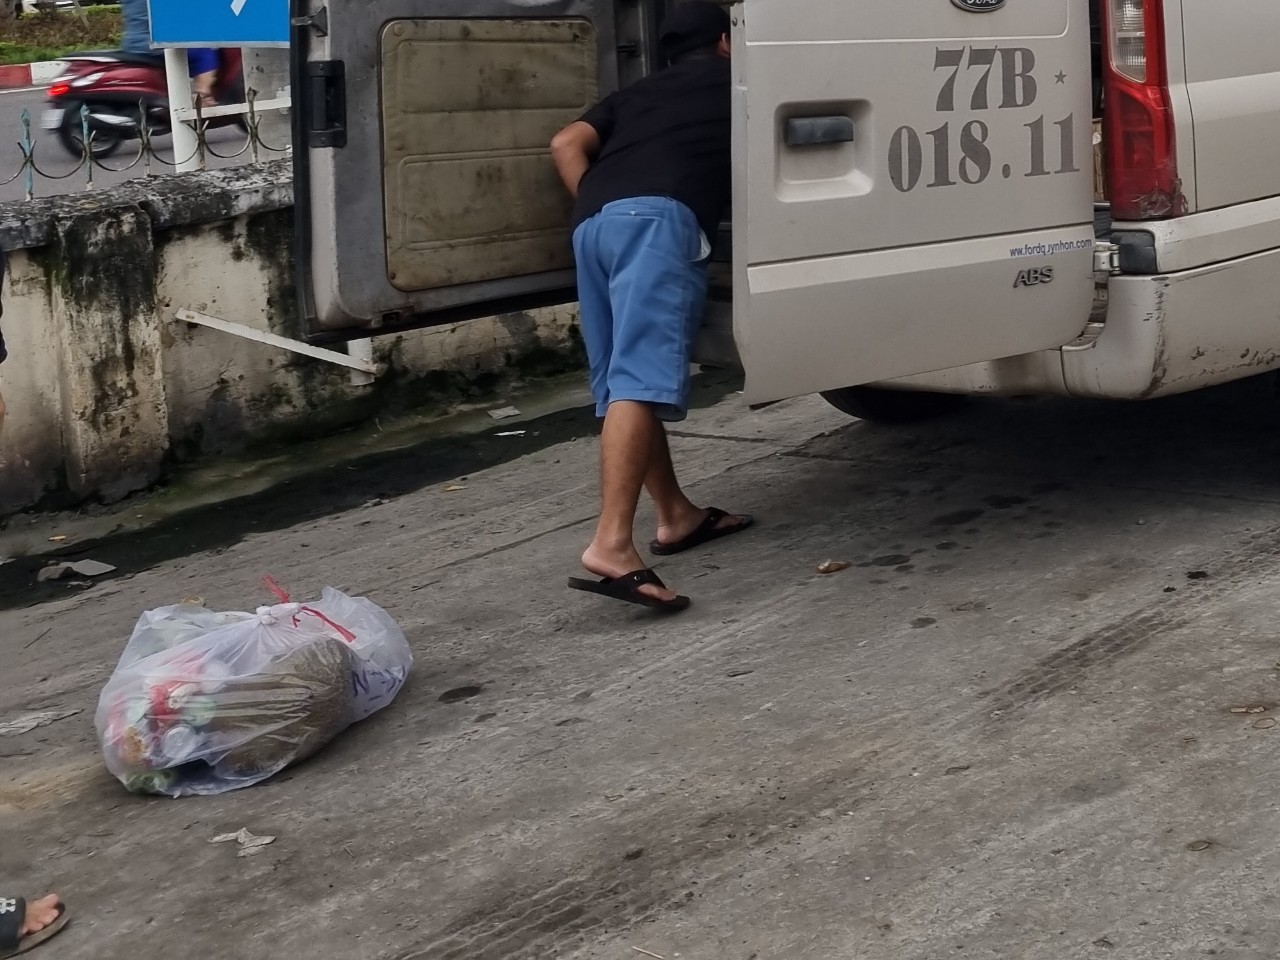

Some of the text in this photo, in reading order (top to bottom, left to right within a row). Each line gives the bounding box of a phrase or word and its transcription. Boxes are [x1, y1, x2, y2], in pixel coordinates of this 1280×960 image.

[933, 44, 1038, 112] 77B
[888, 112, 1080, 192] 018.11
[1013, 266, 1054, 288] ABS
